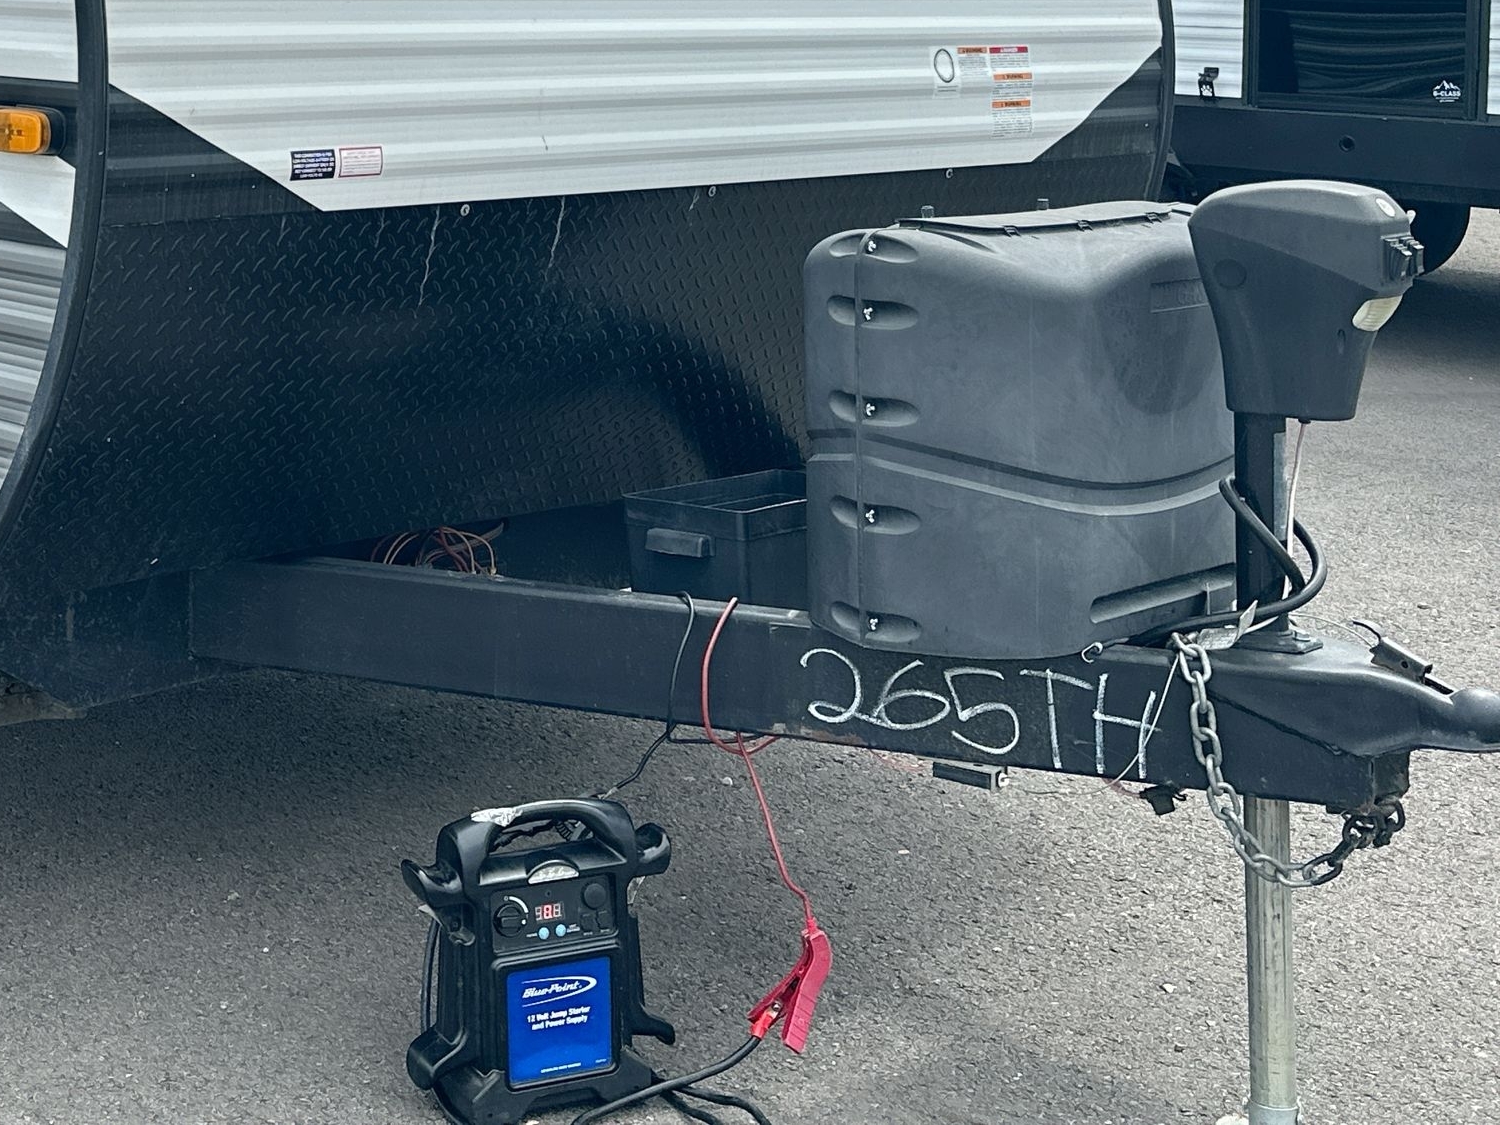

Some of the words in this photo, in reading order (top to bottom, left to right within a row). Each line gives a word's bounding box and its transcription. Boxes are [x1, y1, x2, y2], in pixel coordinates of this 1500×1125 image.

[527, 1014, 536, 1023] 12
[536, 1012, 549, 1021] Volt
[549, 1010, 568, 1019] Jump
[568, 1006, 591, 1015] Starter
[531, 1021, 545, 1030] and
[545, 1019, 566, 1028] Power
[566, 1014, 588, 1024] Supply
